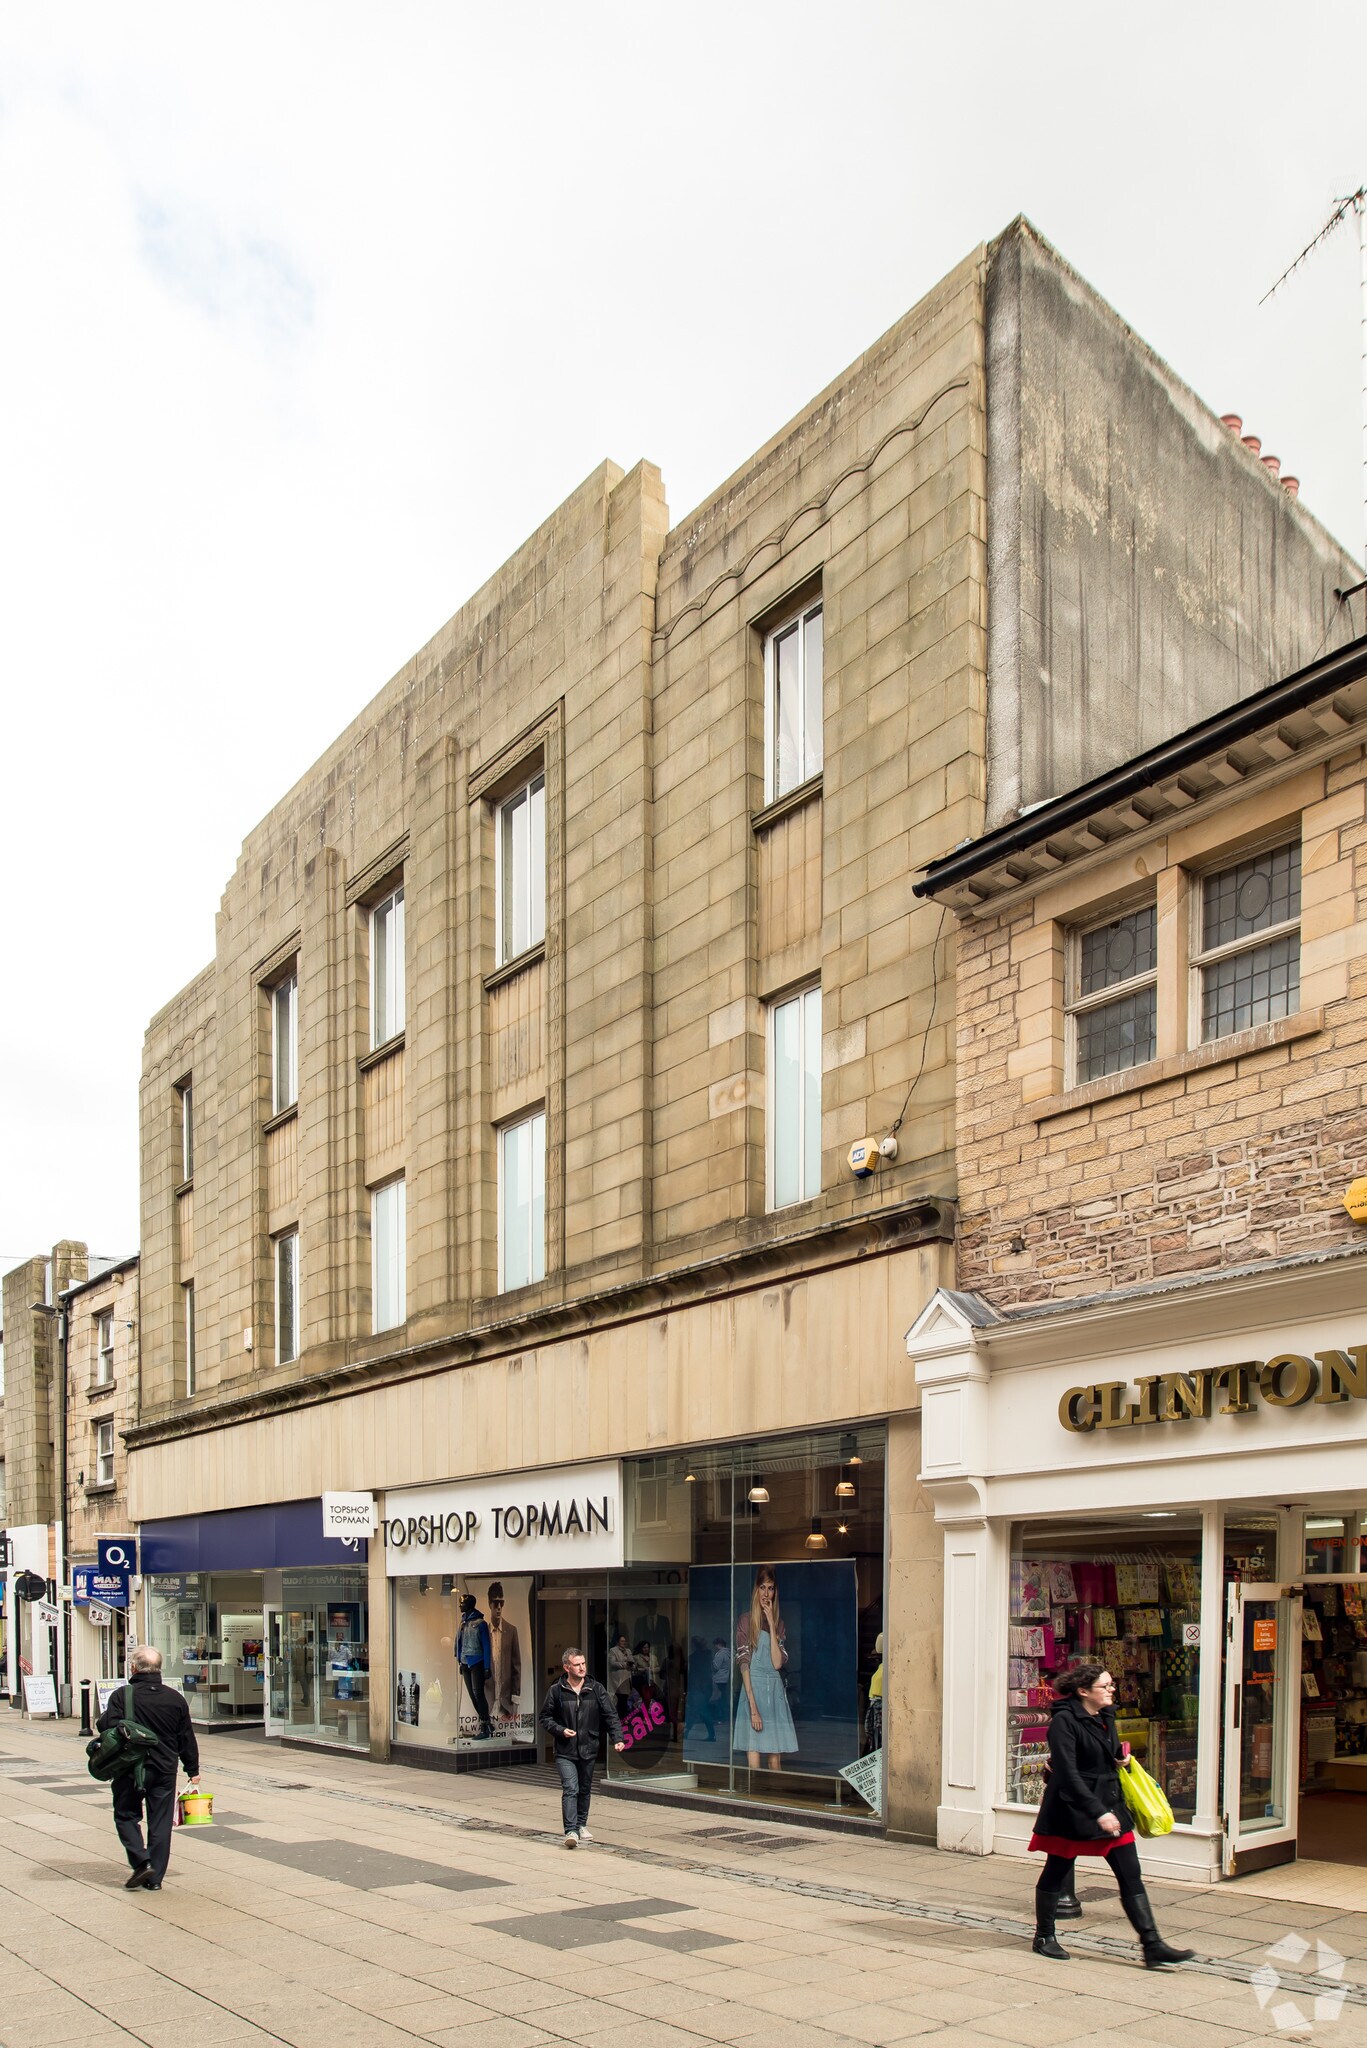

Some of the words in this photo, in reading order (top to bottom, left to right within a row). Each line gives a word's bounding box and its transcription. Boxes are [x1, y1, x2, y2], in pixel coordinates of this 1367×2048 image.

[1058, 1344, 1367, 1433] CLINTON
[330, 1505, 369, 1514] TOPSHOP
[330, 1515, 369, 1524] TOPMAN
[381, 1511, 478, 1548] TOPSHOP
[491, 1496, 609, 1539] TOPMAN
[93, 1576, 121, 1584] MAX
[498, 1722, 521, 1730] OPEN
[621, 1702, 666, 1750] sale
[844, 1763, 861, 1777] ORDER
[859, 1754, 878, 1769] ONLINE
[856, 1770, 874, 1783] COLLECT
[864, 1776, 877, 1789] STORE
[866, 1789, 876, 1798] NEXT
